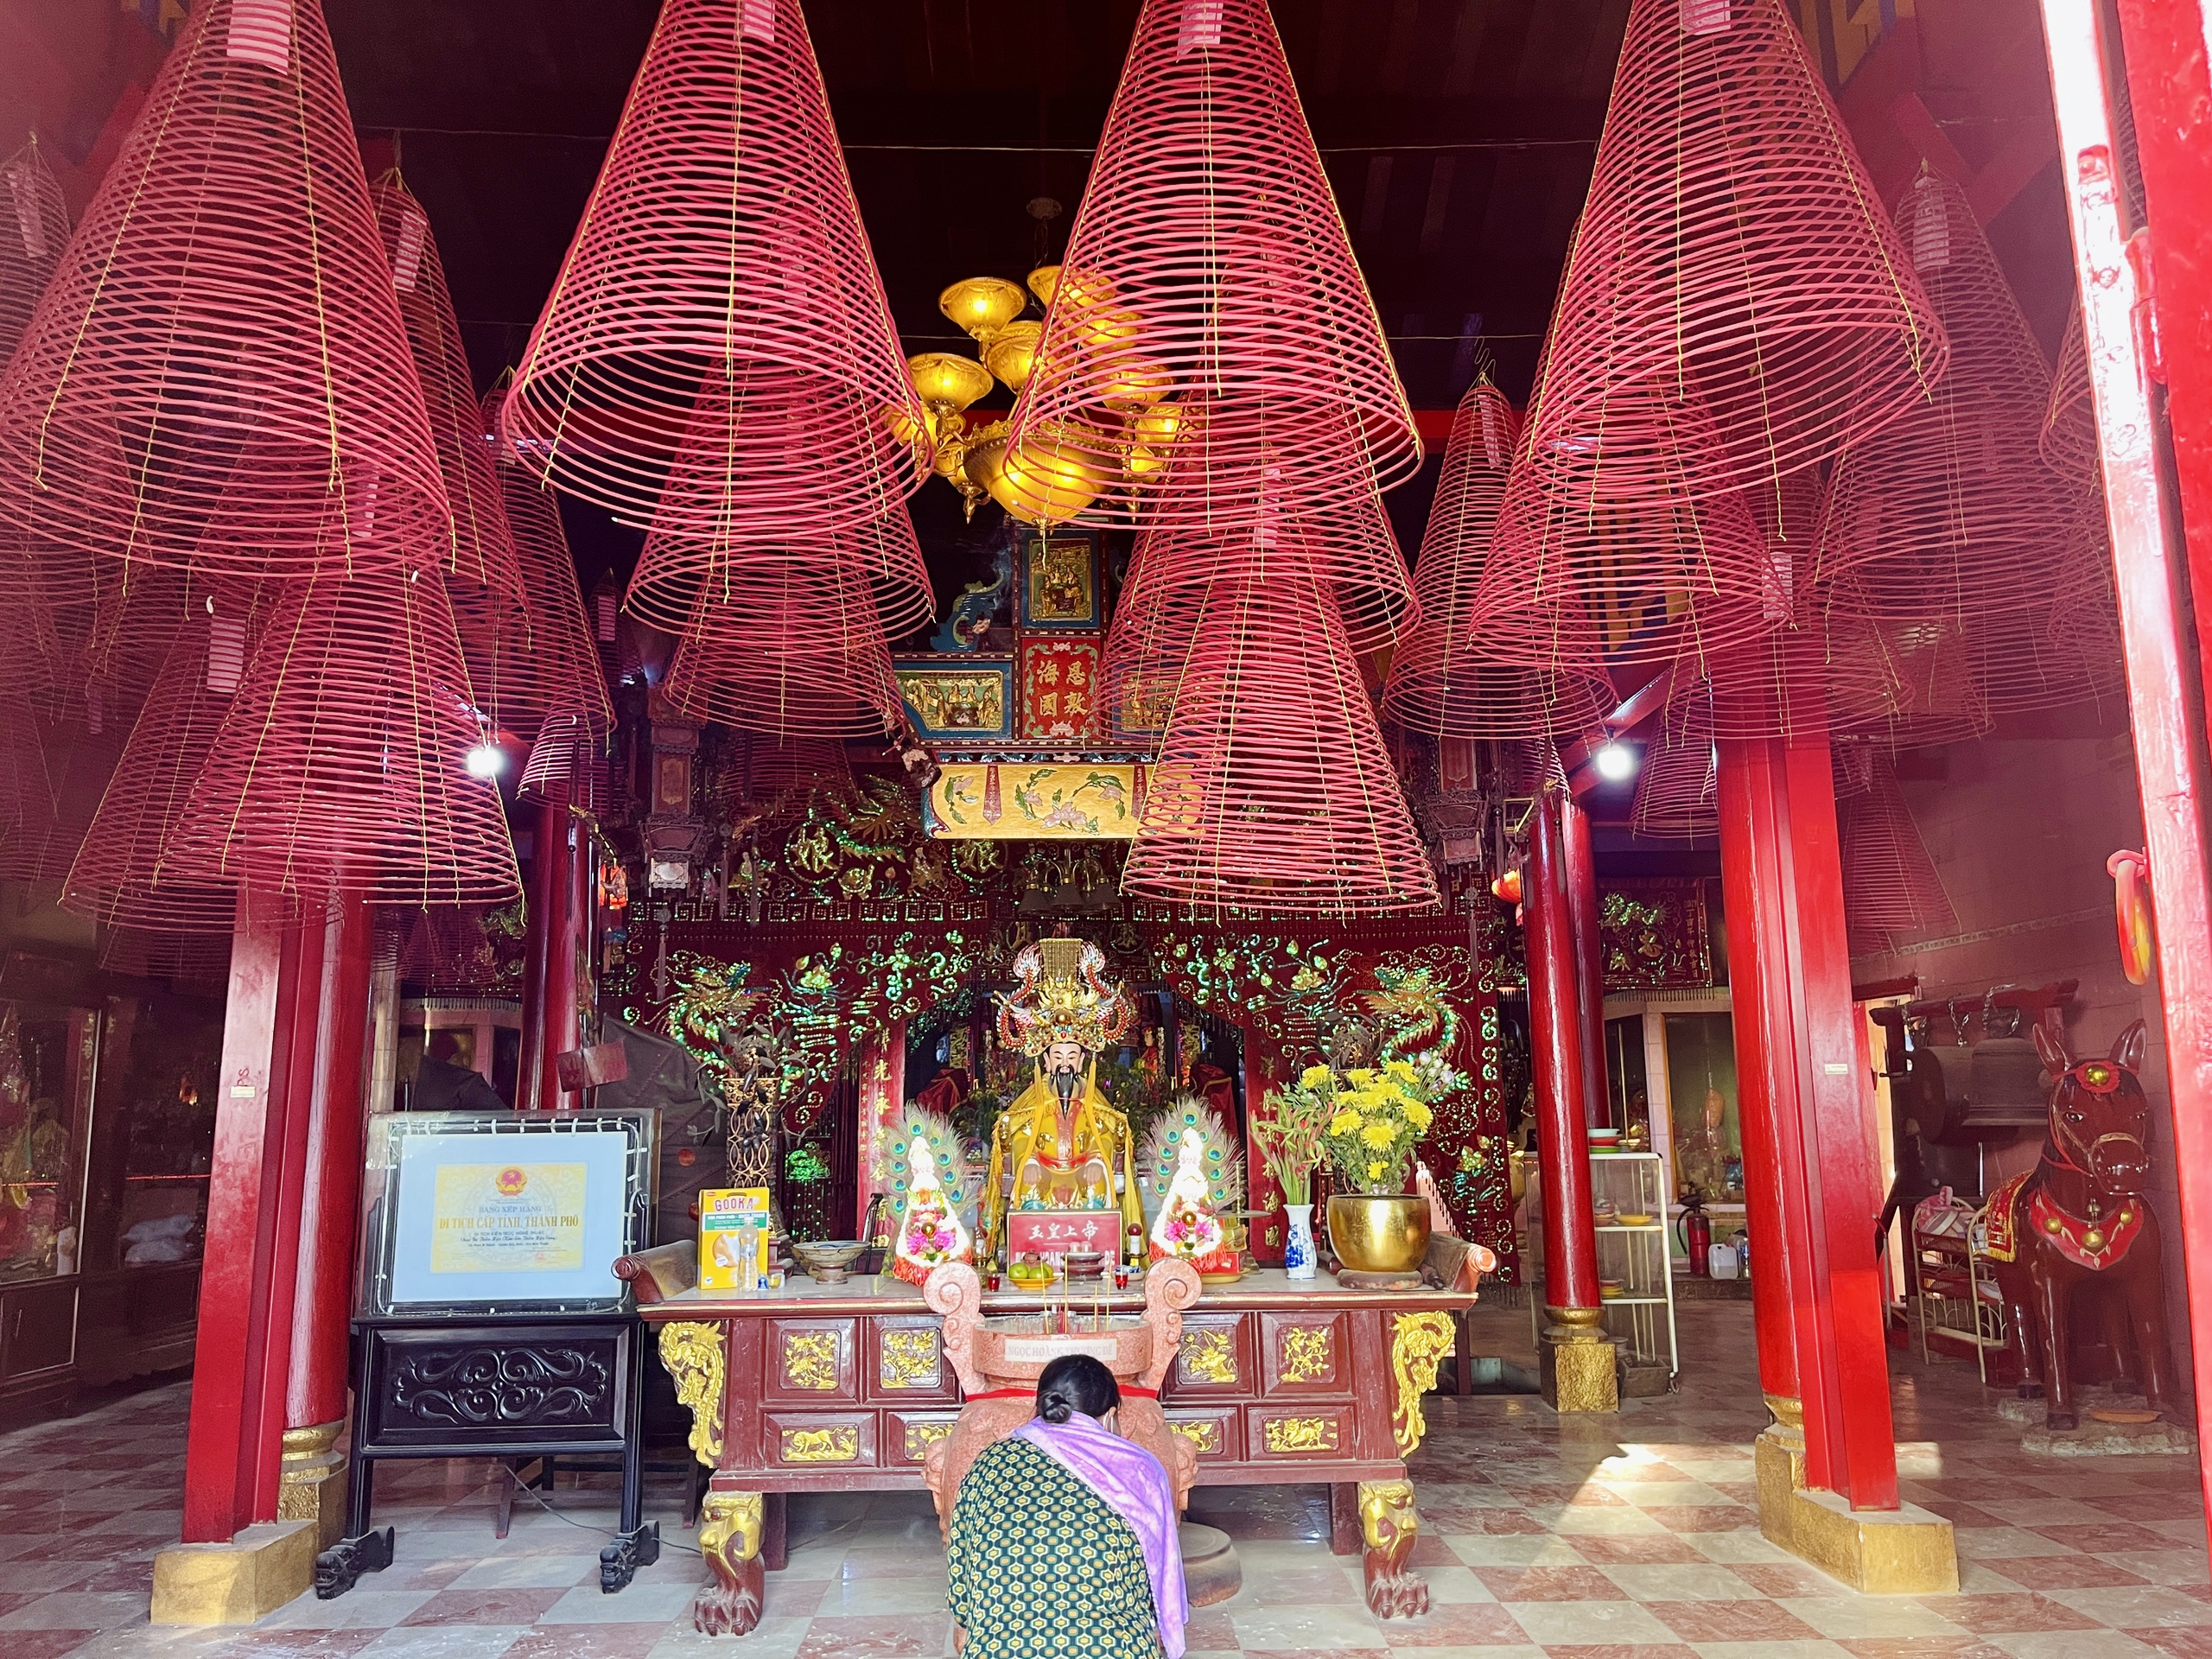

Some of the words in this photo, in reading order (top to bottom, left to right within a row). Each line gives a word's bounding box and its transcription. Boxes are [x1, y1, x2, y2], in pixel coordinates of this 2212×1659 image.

[715, 1198, 753, 1211] GOOKA
[439, 1217, 449, 1229] DI
[1028, 1219, 1099, 1241] 玉皇上帝
